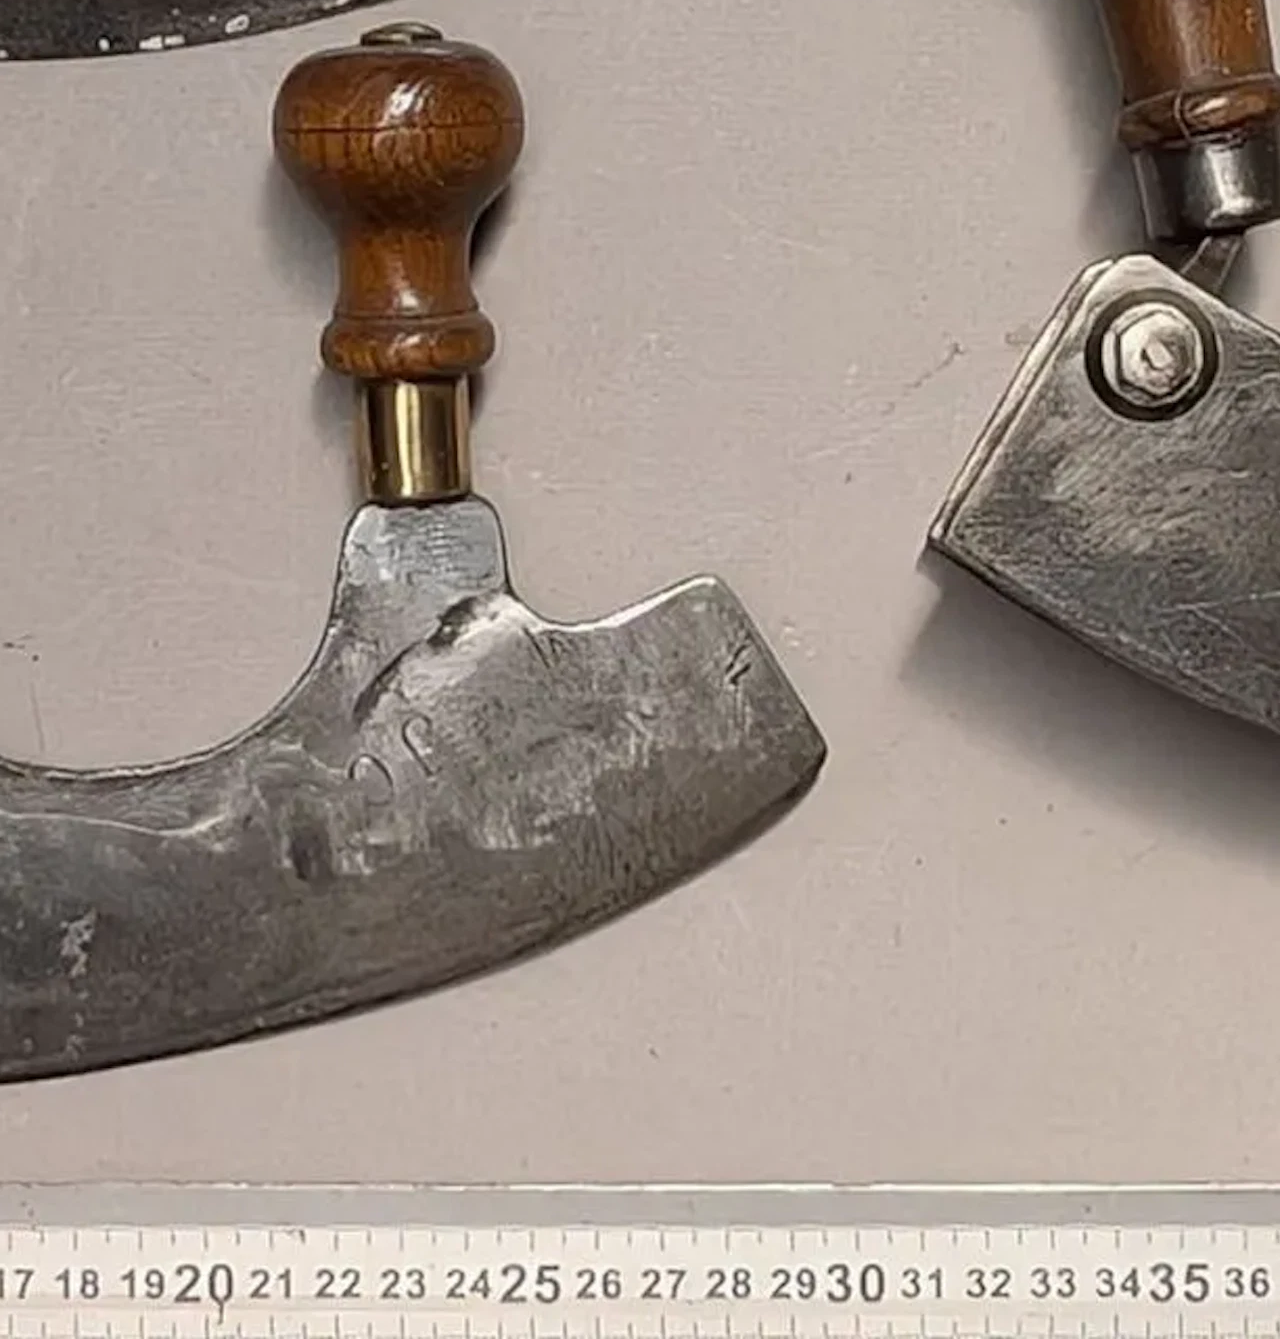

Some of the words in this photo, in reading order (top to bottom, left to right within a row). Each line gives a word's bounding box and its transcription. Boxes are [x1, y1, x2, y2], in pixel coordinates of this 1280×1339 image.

[54, 1267, 101, 1301] 18
[119, 1267, 166, 1301] 19
[172, 1263, 234, 1305] 20
[248, 1267, 292, 1301] 21
[313, 1267, 362, 1301] 22
[379, 1268, 427, 1301] 23
[445, 1267, 492, 1301] 24
[498, 1262, 562, 1305] 25
[575, 1267, 622, 1301] 26
[640, 1267, 688, 1301] 27
[704, 1267, 752, 1301] 28
[769, 1267, 817, 1301] 29
[826, 1263, 886, 1304] 30
[900, 1266, 943, 1300] 31
[965, 1267, 1012, 1299] 32
[1029, 1267, 1077, 1300] 33
[1095, 1266, 1141, 1299] 34
[1149, 1262, 1210, 1304] 35
[1224, 1266, 1271, 1299] 36
